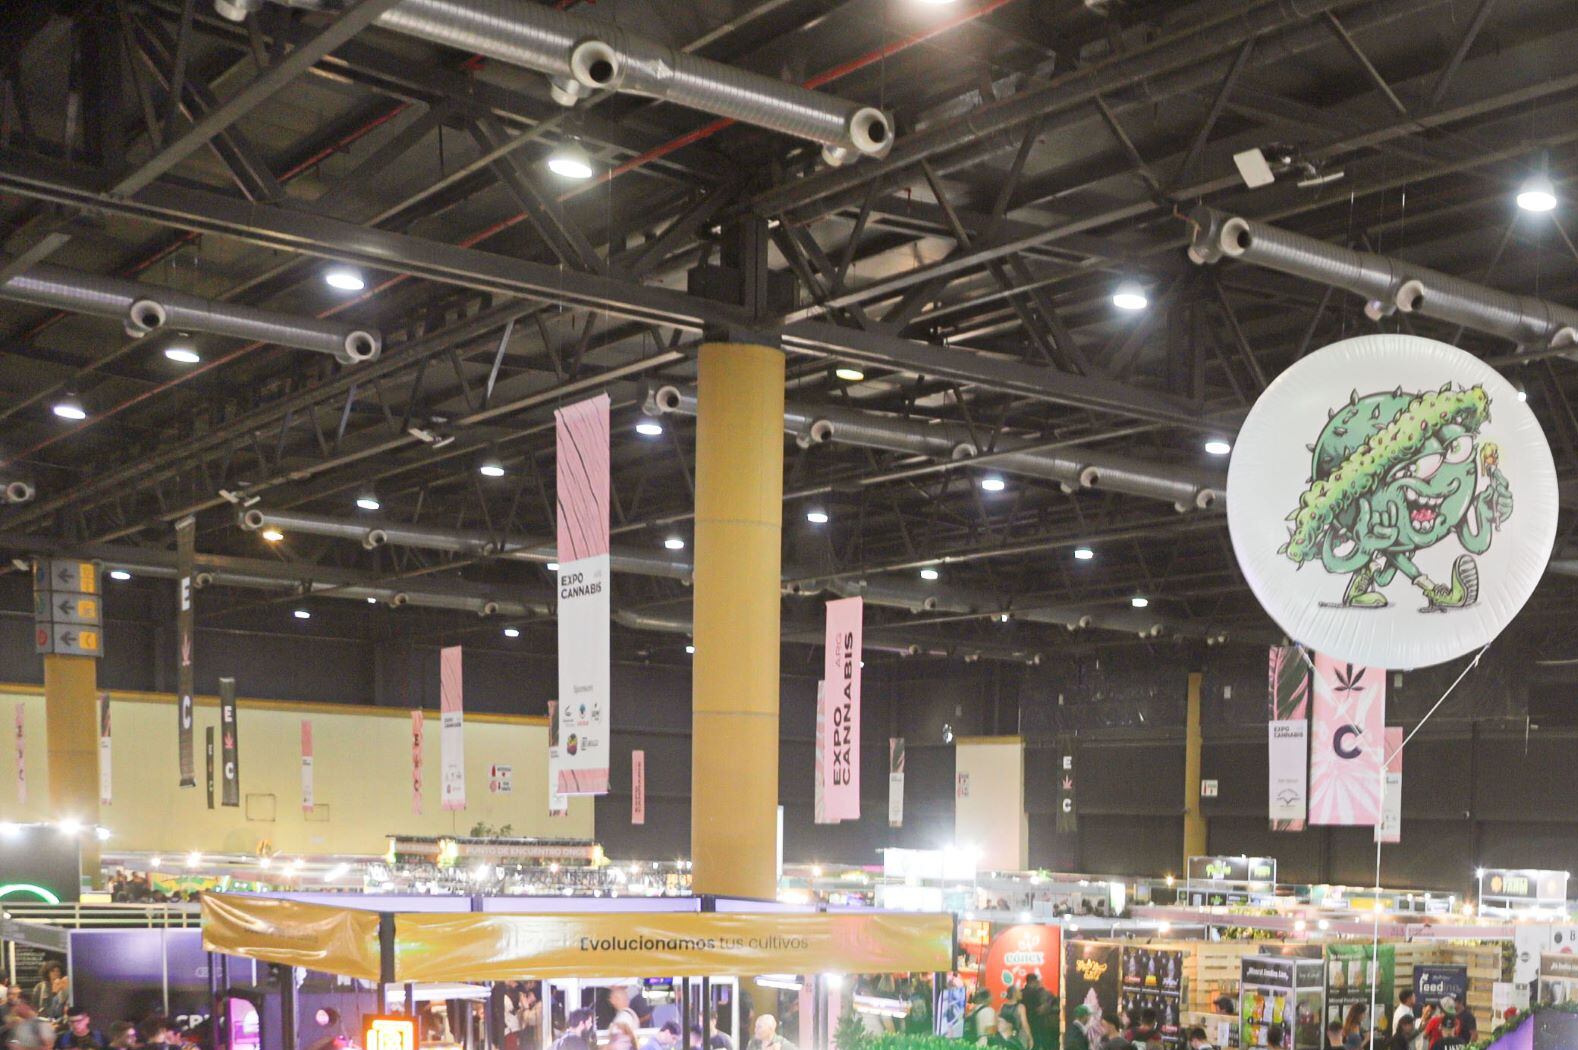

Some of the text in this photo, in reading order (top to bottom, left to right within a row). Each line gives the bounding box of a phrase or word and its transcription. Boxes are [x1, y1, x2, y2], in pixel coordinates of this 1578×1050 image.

[181, 576, 191, 612] E
[561, 572, 584, 587] EXPO
[561, 581, 602, 599] CANNABIS
[841, 631, 854, 786] CANNABIS
[833, 706, 842, 786] EXPO
[1333, 724, 1363, 760] C
[580, 935, 809, 951] Evolucionamos tus cultivos
